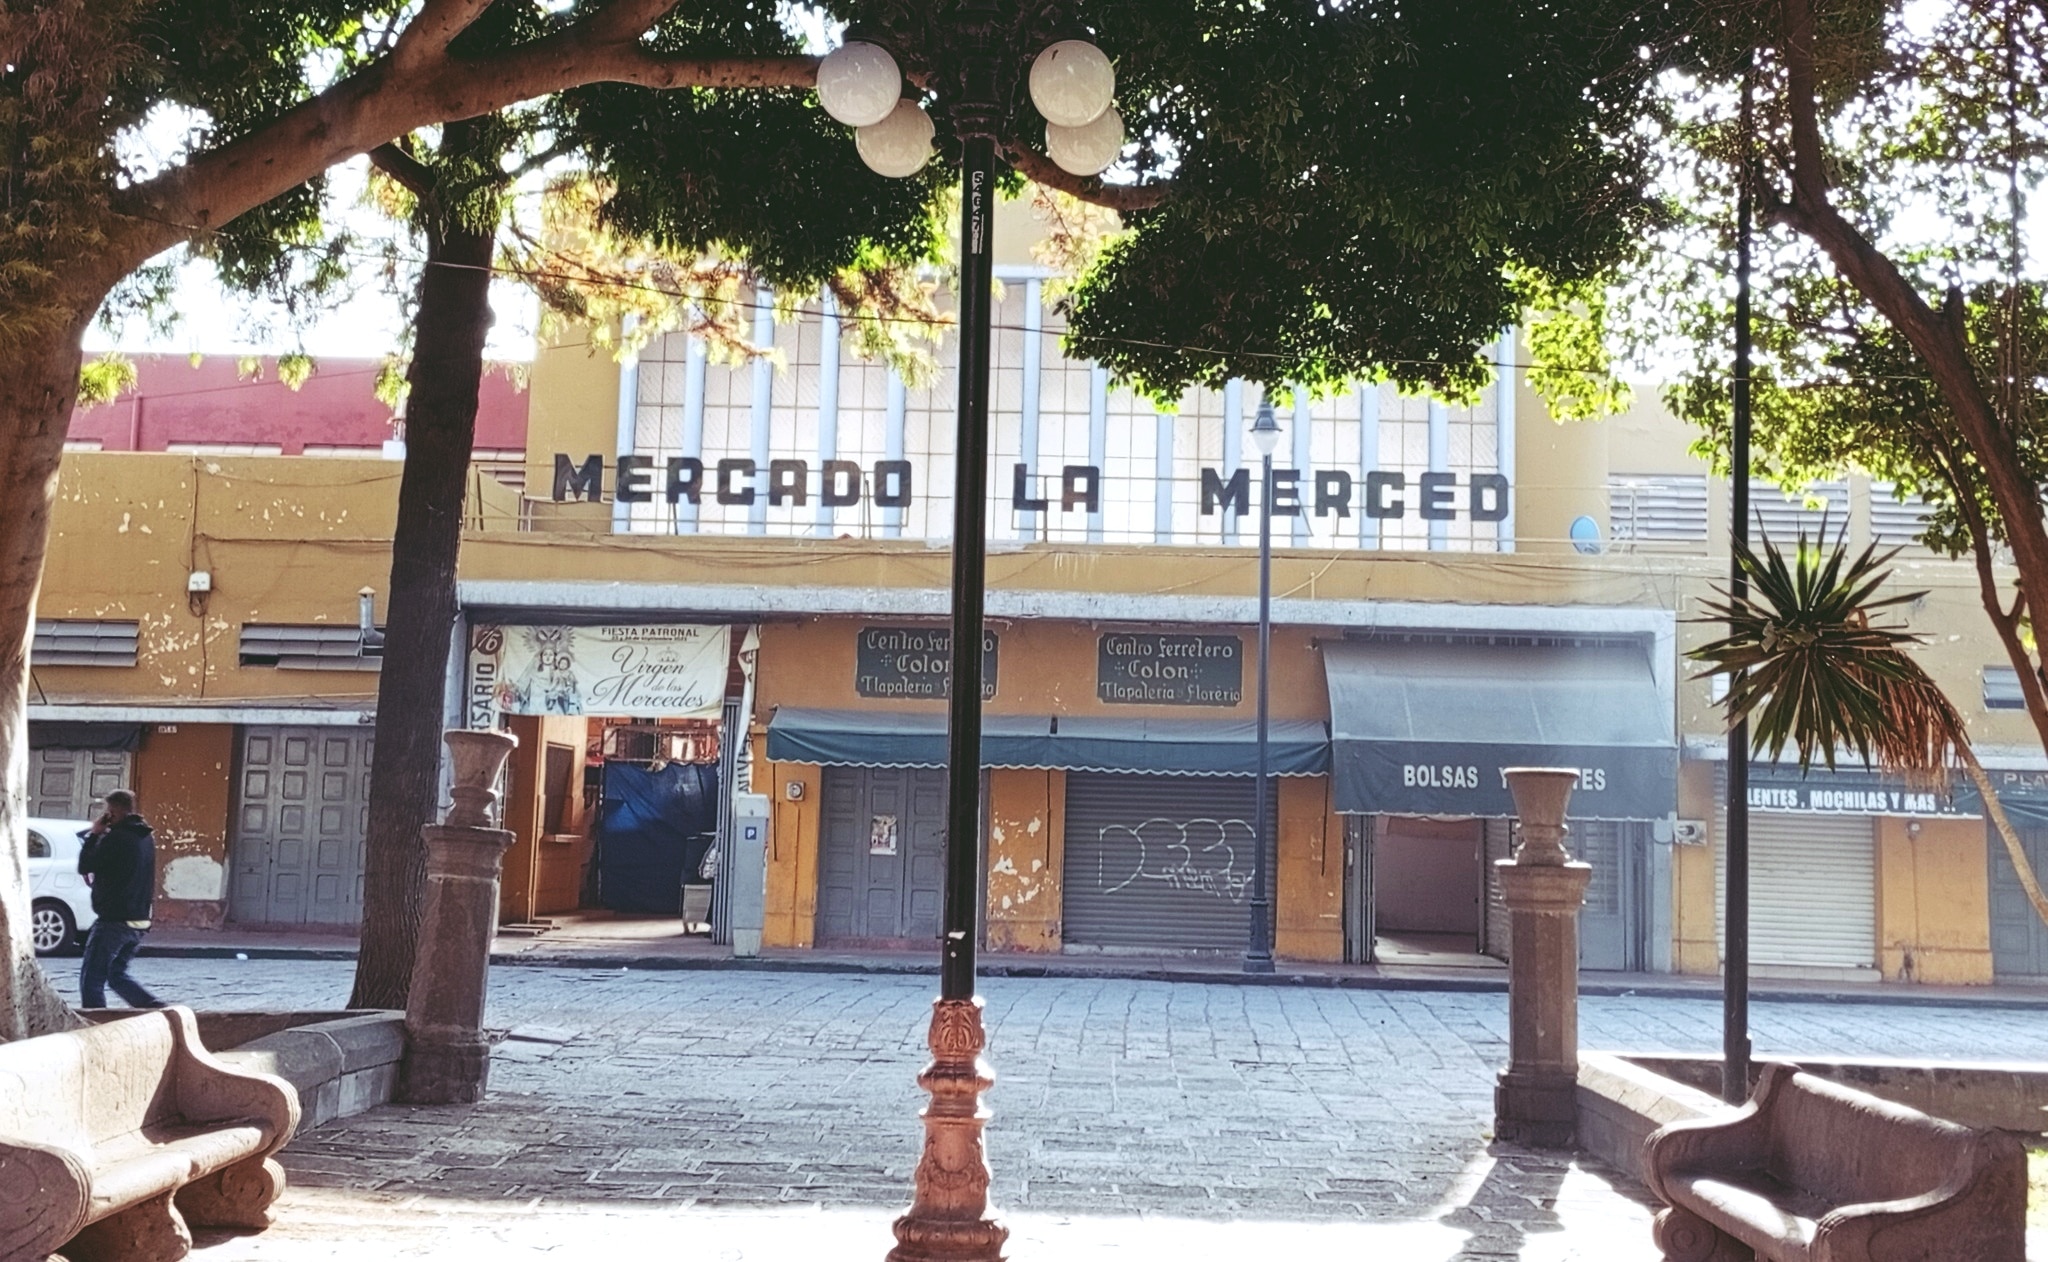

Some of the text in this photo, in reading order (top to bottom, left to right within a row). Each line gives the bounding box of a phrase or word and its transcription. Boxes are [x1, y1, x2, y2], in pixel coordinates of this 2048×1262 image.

[553, 453, 1509, 521] MERCADO LA MERCED
[602, 627, 699, 637] FIESTA PATRONAL
[867, 631, 923, 650] Centro
[1106, 636, 1233, 659] Centro Ferretero
[611, 645, 684, 688] Virgen
[1128, 660, 1188, 680] Colon
[586, 673, 702, 707] Mercedes
[651, 677, 682, 692] de las
[1403, 765, 1478, 788] BOLSAS
[1810, 790, 1887, 809] MOCHILAS
[1889, 791, 1900, 809] Y
[1904, 793, 1936, 812] MAS
